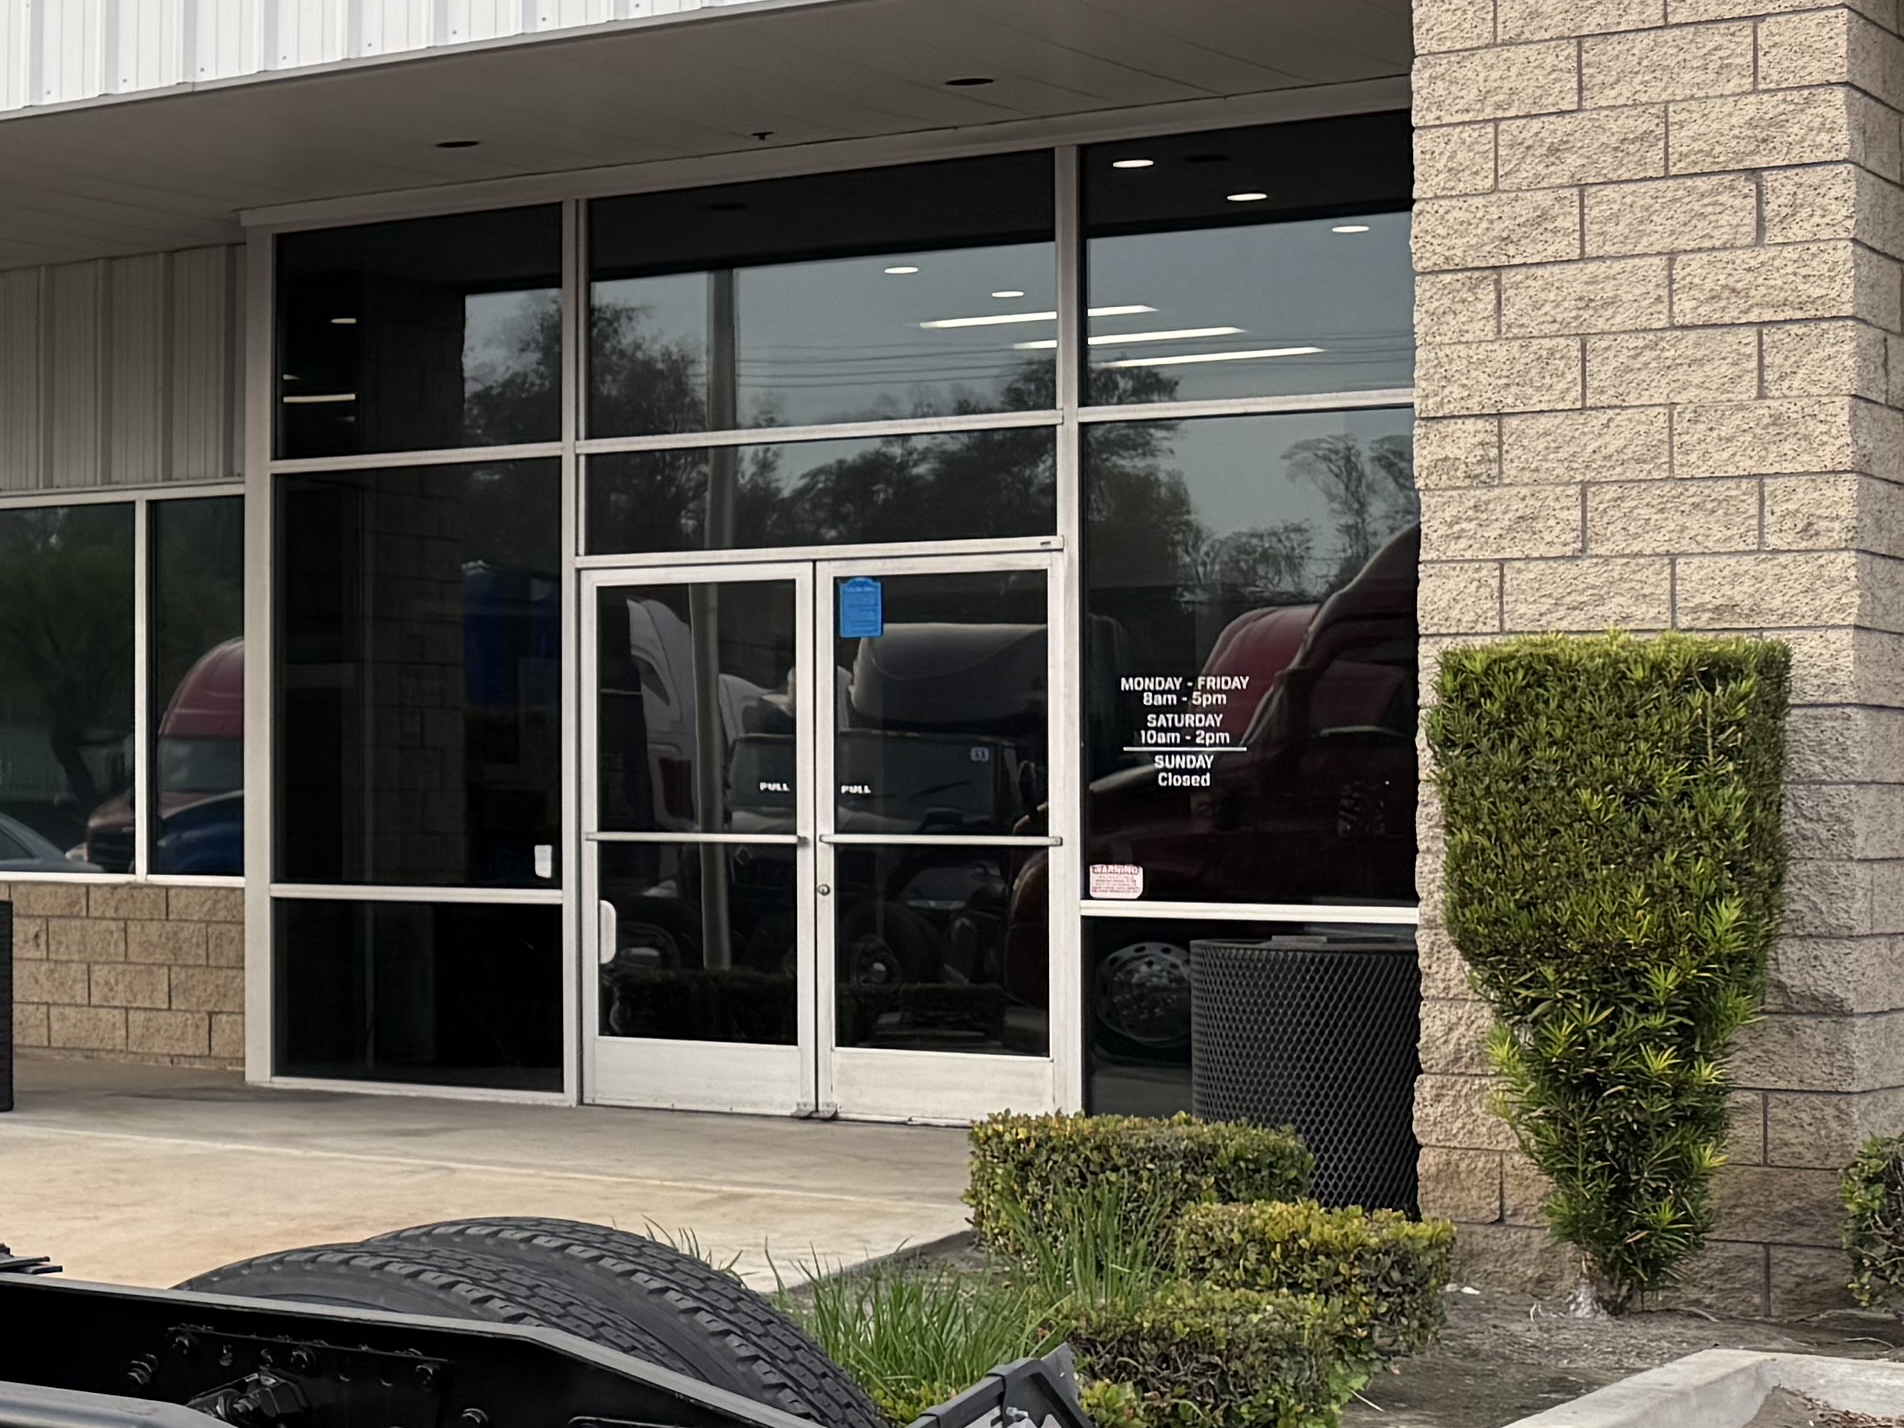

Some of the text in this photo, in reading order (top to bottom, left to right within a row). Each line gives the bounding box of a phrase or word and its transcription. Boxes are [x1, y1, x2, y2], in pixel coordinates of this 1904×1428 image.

[1120, 676, 1183, 691] MONDAY
[1197, 676, 1250, 690] FRIDAY
[1143, 692, 1177, 706] 8am
[1192, 692, 1227, 707] 5pm
[1146, 713, 1223, 727] SATURDAY
[1140, 730, 1181, 744] 10am
[1195, 730, 1230, 746] 2pm
[1154, 755, 1214, 769] SUNDAY
[759, 781, 790, 792] PULL
[1158, 772, 1211, 787] Closed
[840, 784, 872, 794] PULL
